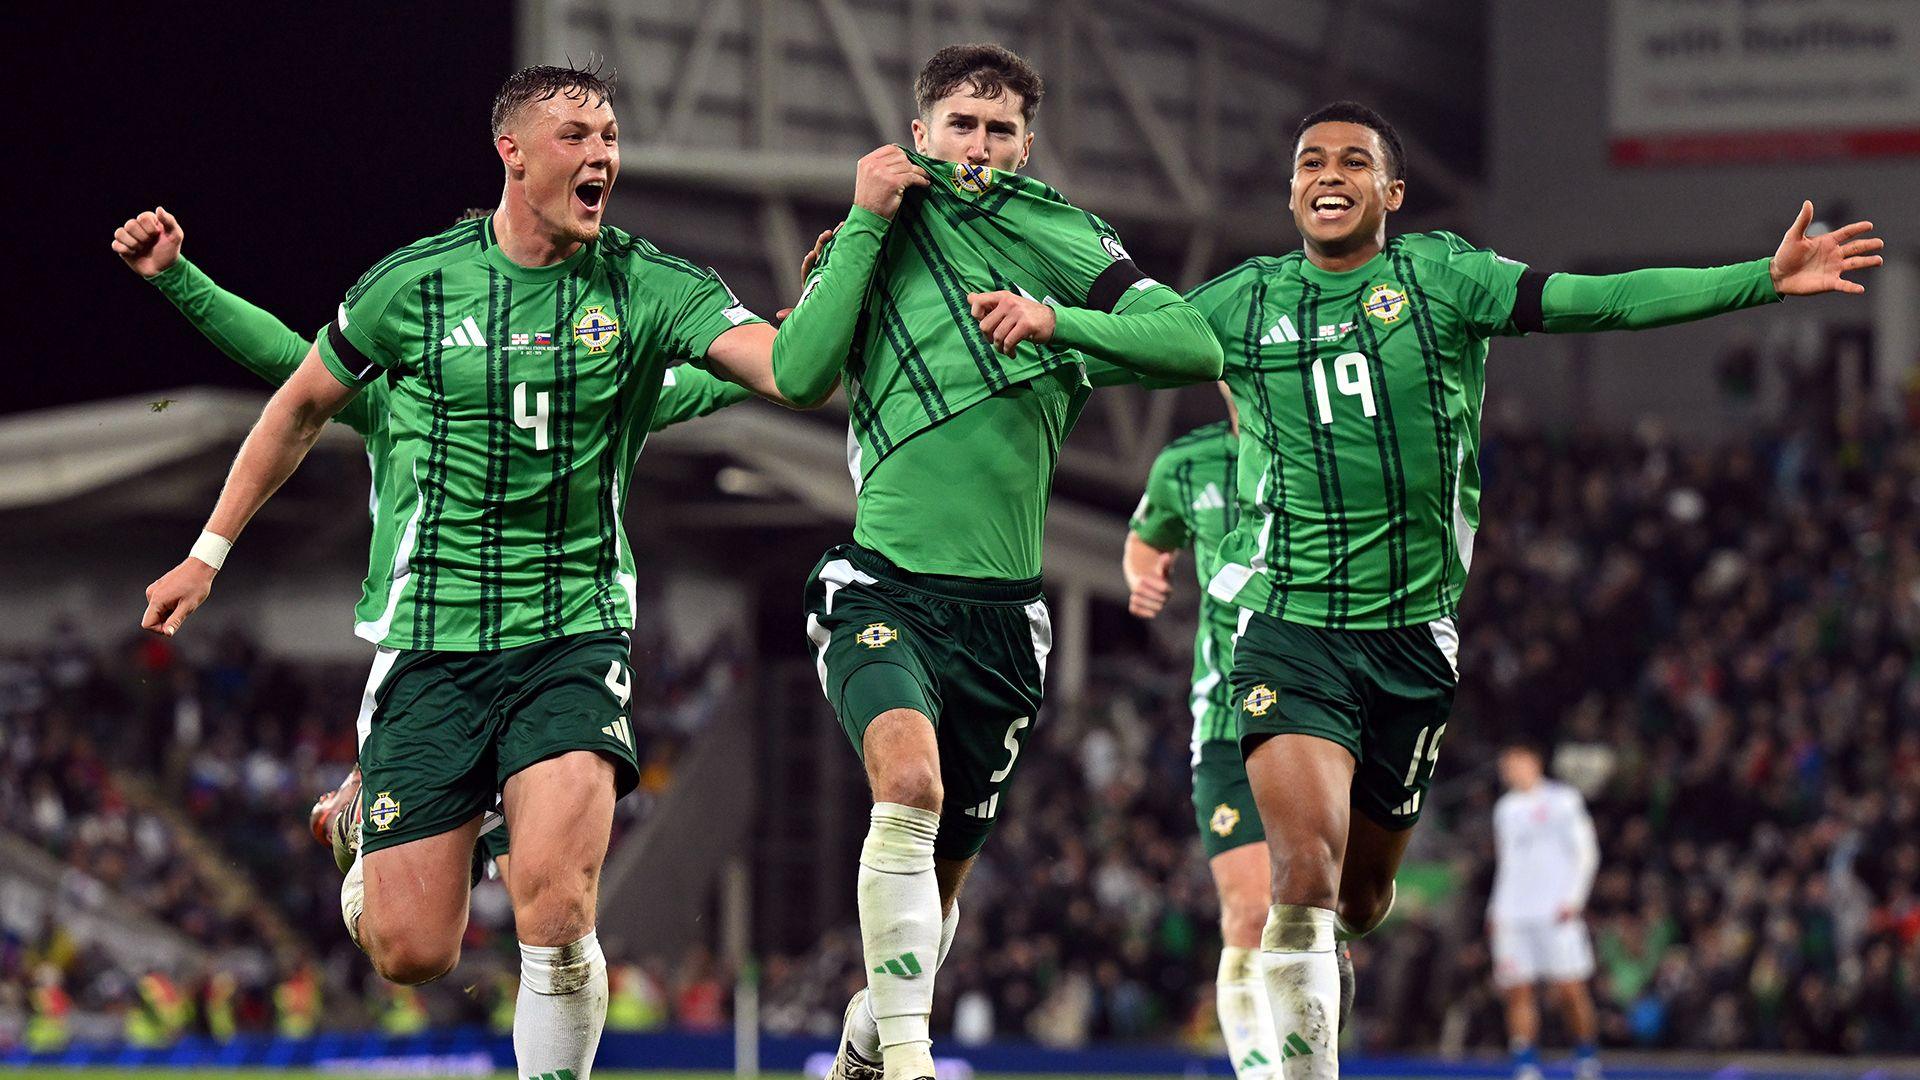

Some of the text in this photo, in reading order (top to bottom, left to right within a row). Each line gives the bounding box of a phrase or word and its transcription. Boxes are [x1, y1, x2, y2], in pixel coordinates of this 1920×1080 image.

[514, 382, 549, 451] 4
[1312, 352, 1377, 424] 19
[604, 660, 631, 708] 4
[990, 716, 1029, 782] 5
